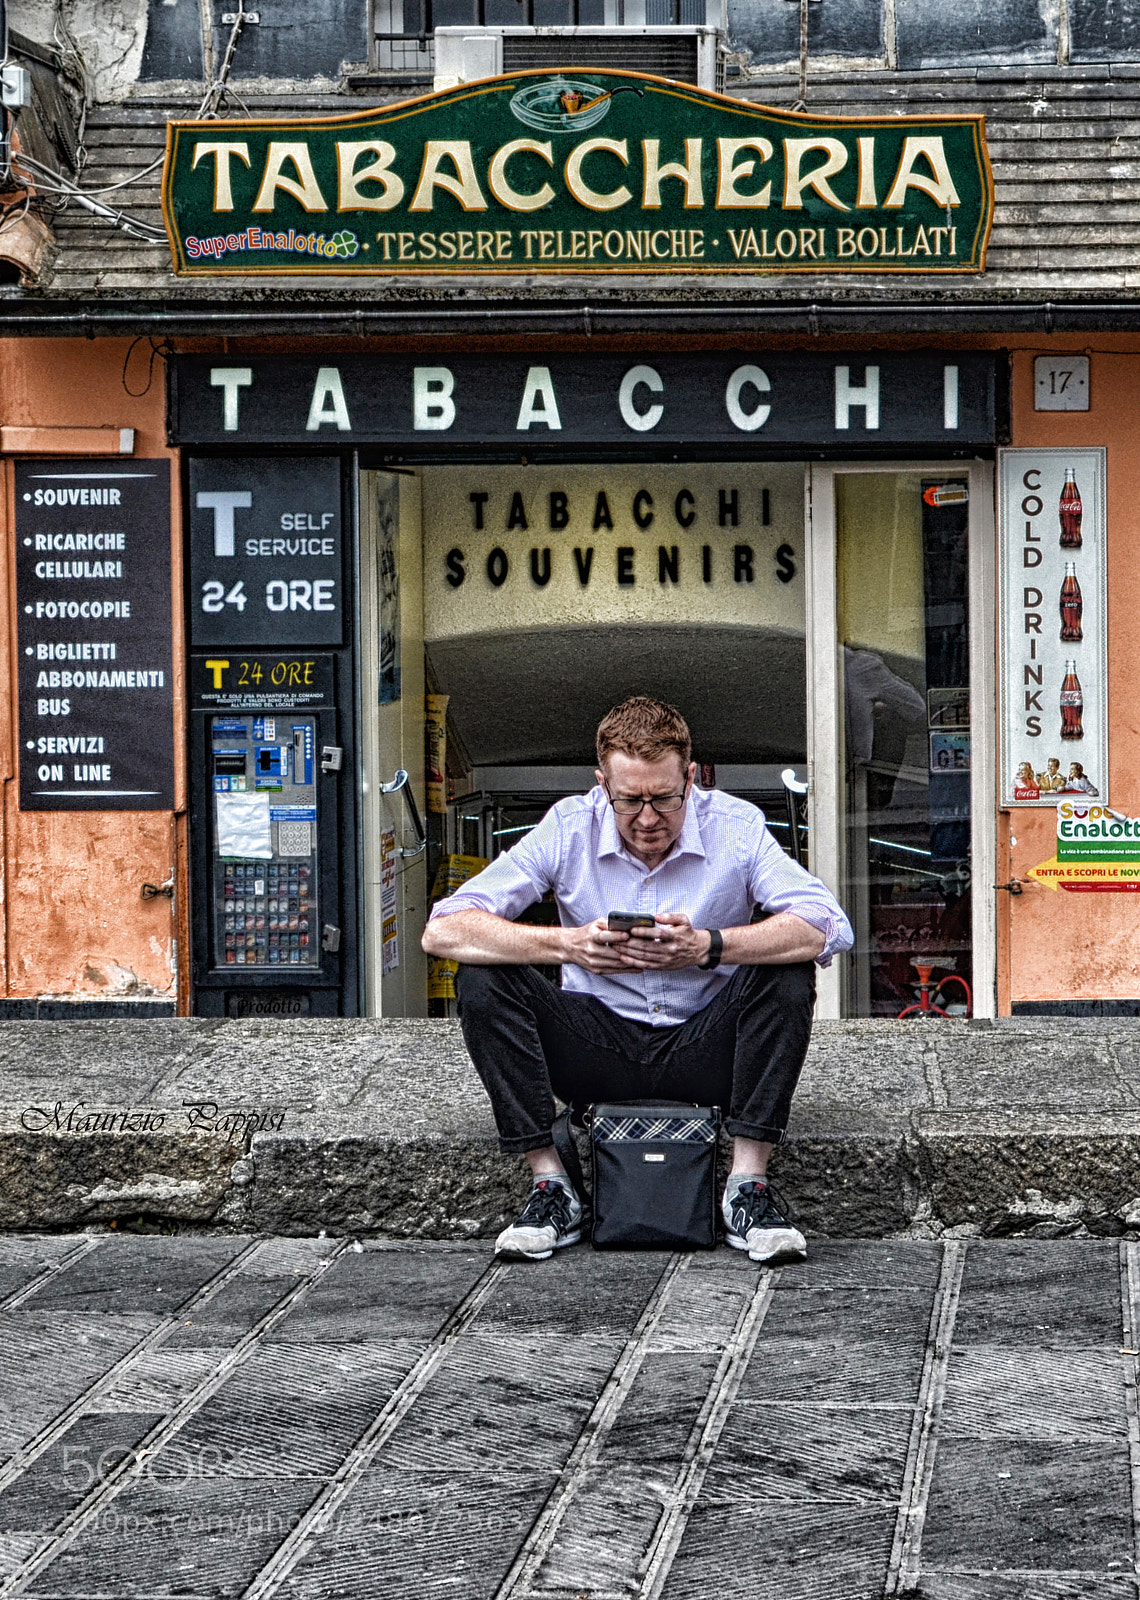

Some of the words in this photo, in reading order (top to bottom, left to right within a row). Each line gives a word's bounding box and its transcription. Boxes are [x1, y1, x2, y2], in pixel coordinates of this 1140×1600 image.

[191, 137, 961, 212] TABACCHERIA
[186, 228, 337, 259] SuperEnalotto
[377, 230, 513, 261] TESSERE
[520, 228, 704, 260] TELEFONICHE
[729, 226, 826, 259] VALORI
[836, 225, 958, 258] BOLLATI
[1047, 370, 1073, 395] 17
[210, 364, 960, 432] TABACCHI
[34, 488, 122, 506] SOUVENIR
[469, 488, 771, 531] TABACCHI
[1021, 469, 1044, 568] COLD
[196, 490, 253, 557] T
[281, 513, 335, 531] SELF
[35, 533, 126, 551] RICARICHE
[245, 538, 335, 557] SERVICE
[35, 561, 123, 579] CELLULARI
[445, 543, 798, 588] SOUVENIRS
[202, 580, 248, 613] 24
[265, 580, 336, 612] ORE
[36, 601, 131, 619] FOTOCOPIE
[37, 643, 117, 660] BIGLIETTI
[1023, 587, 1044, 738] DRINKS
[37, 671, 165, 688] ABBONAMENTI
[205, 659, 230, 690] T
[237, 661, 264, 686] 24
[270, 661, 316, 686] ORE
[37, 698, 71, 716] BUS
[37, 737, 104, 754] SERVIZI
[38, 764, 64, 781] ON
[74, 764, 112, 781] LINE
[1036, 869, 1064, 877] ENTRA
[1066, 869, 1073, 877] E
[1074, 869, 1106, 877] SCOPRI
[1108, 869, 1119, 877] LE
[236, 998, 302, 1015] Prodotto
